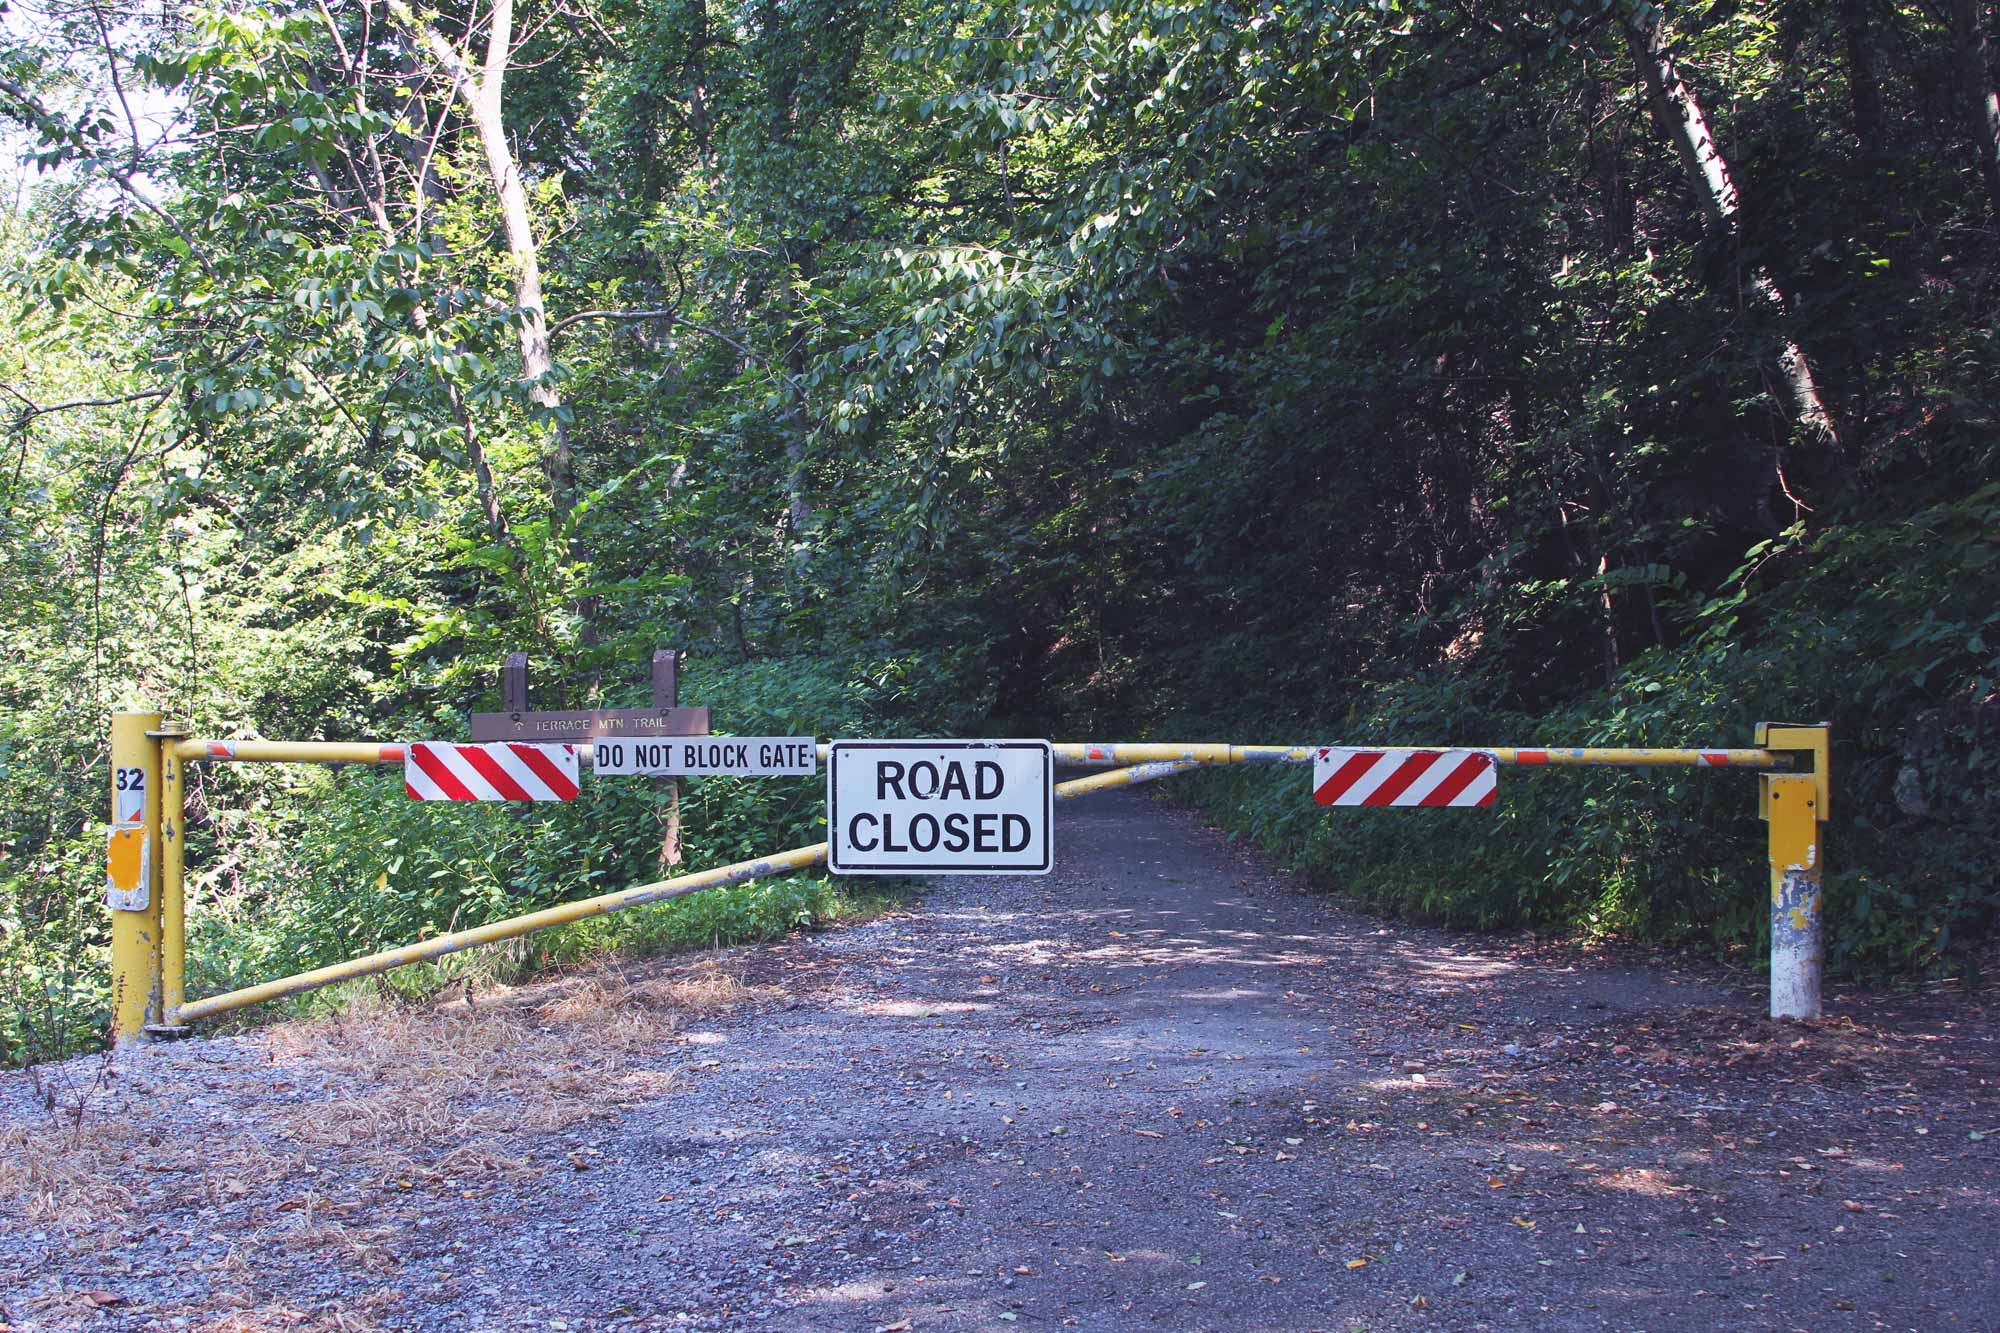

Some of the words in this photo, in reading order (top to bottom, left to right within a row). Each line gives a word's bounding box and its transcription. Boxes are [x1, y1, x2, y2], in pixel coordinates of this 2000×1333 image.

[536, 719, 590, 731] TERRACE
[599, 718, 624, 729] MTN
[632, 717, 667, 729] TRAIL
[598, 744, 624, 768] DO
[635, 744, 673, 768] NOT
[684, 744, 748, 768] BLOCK
[759, 744, 809, 768] GATE
[116, 768, 145, 791] 32
[877, 760, 1005, 801] ROAD
[848, 812, 1032, 853] CLOSED
